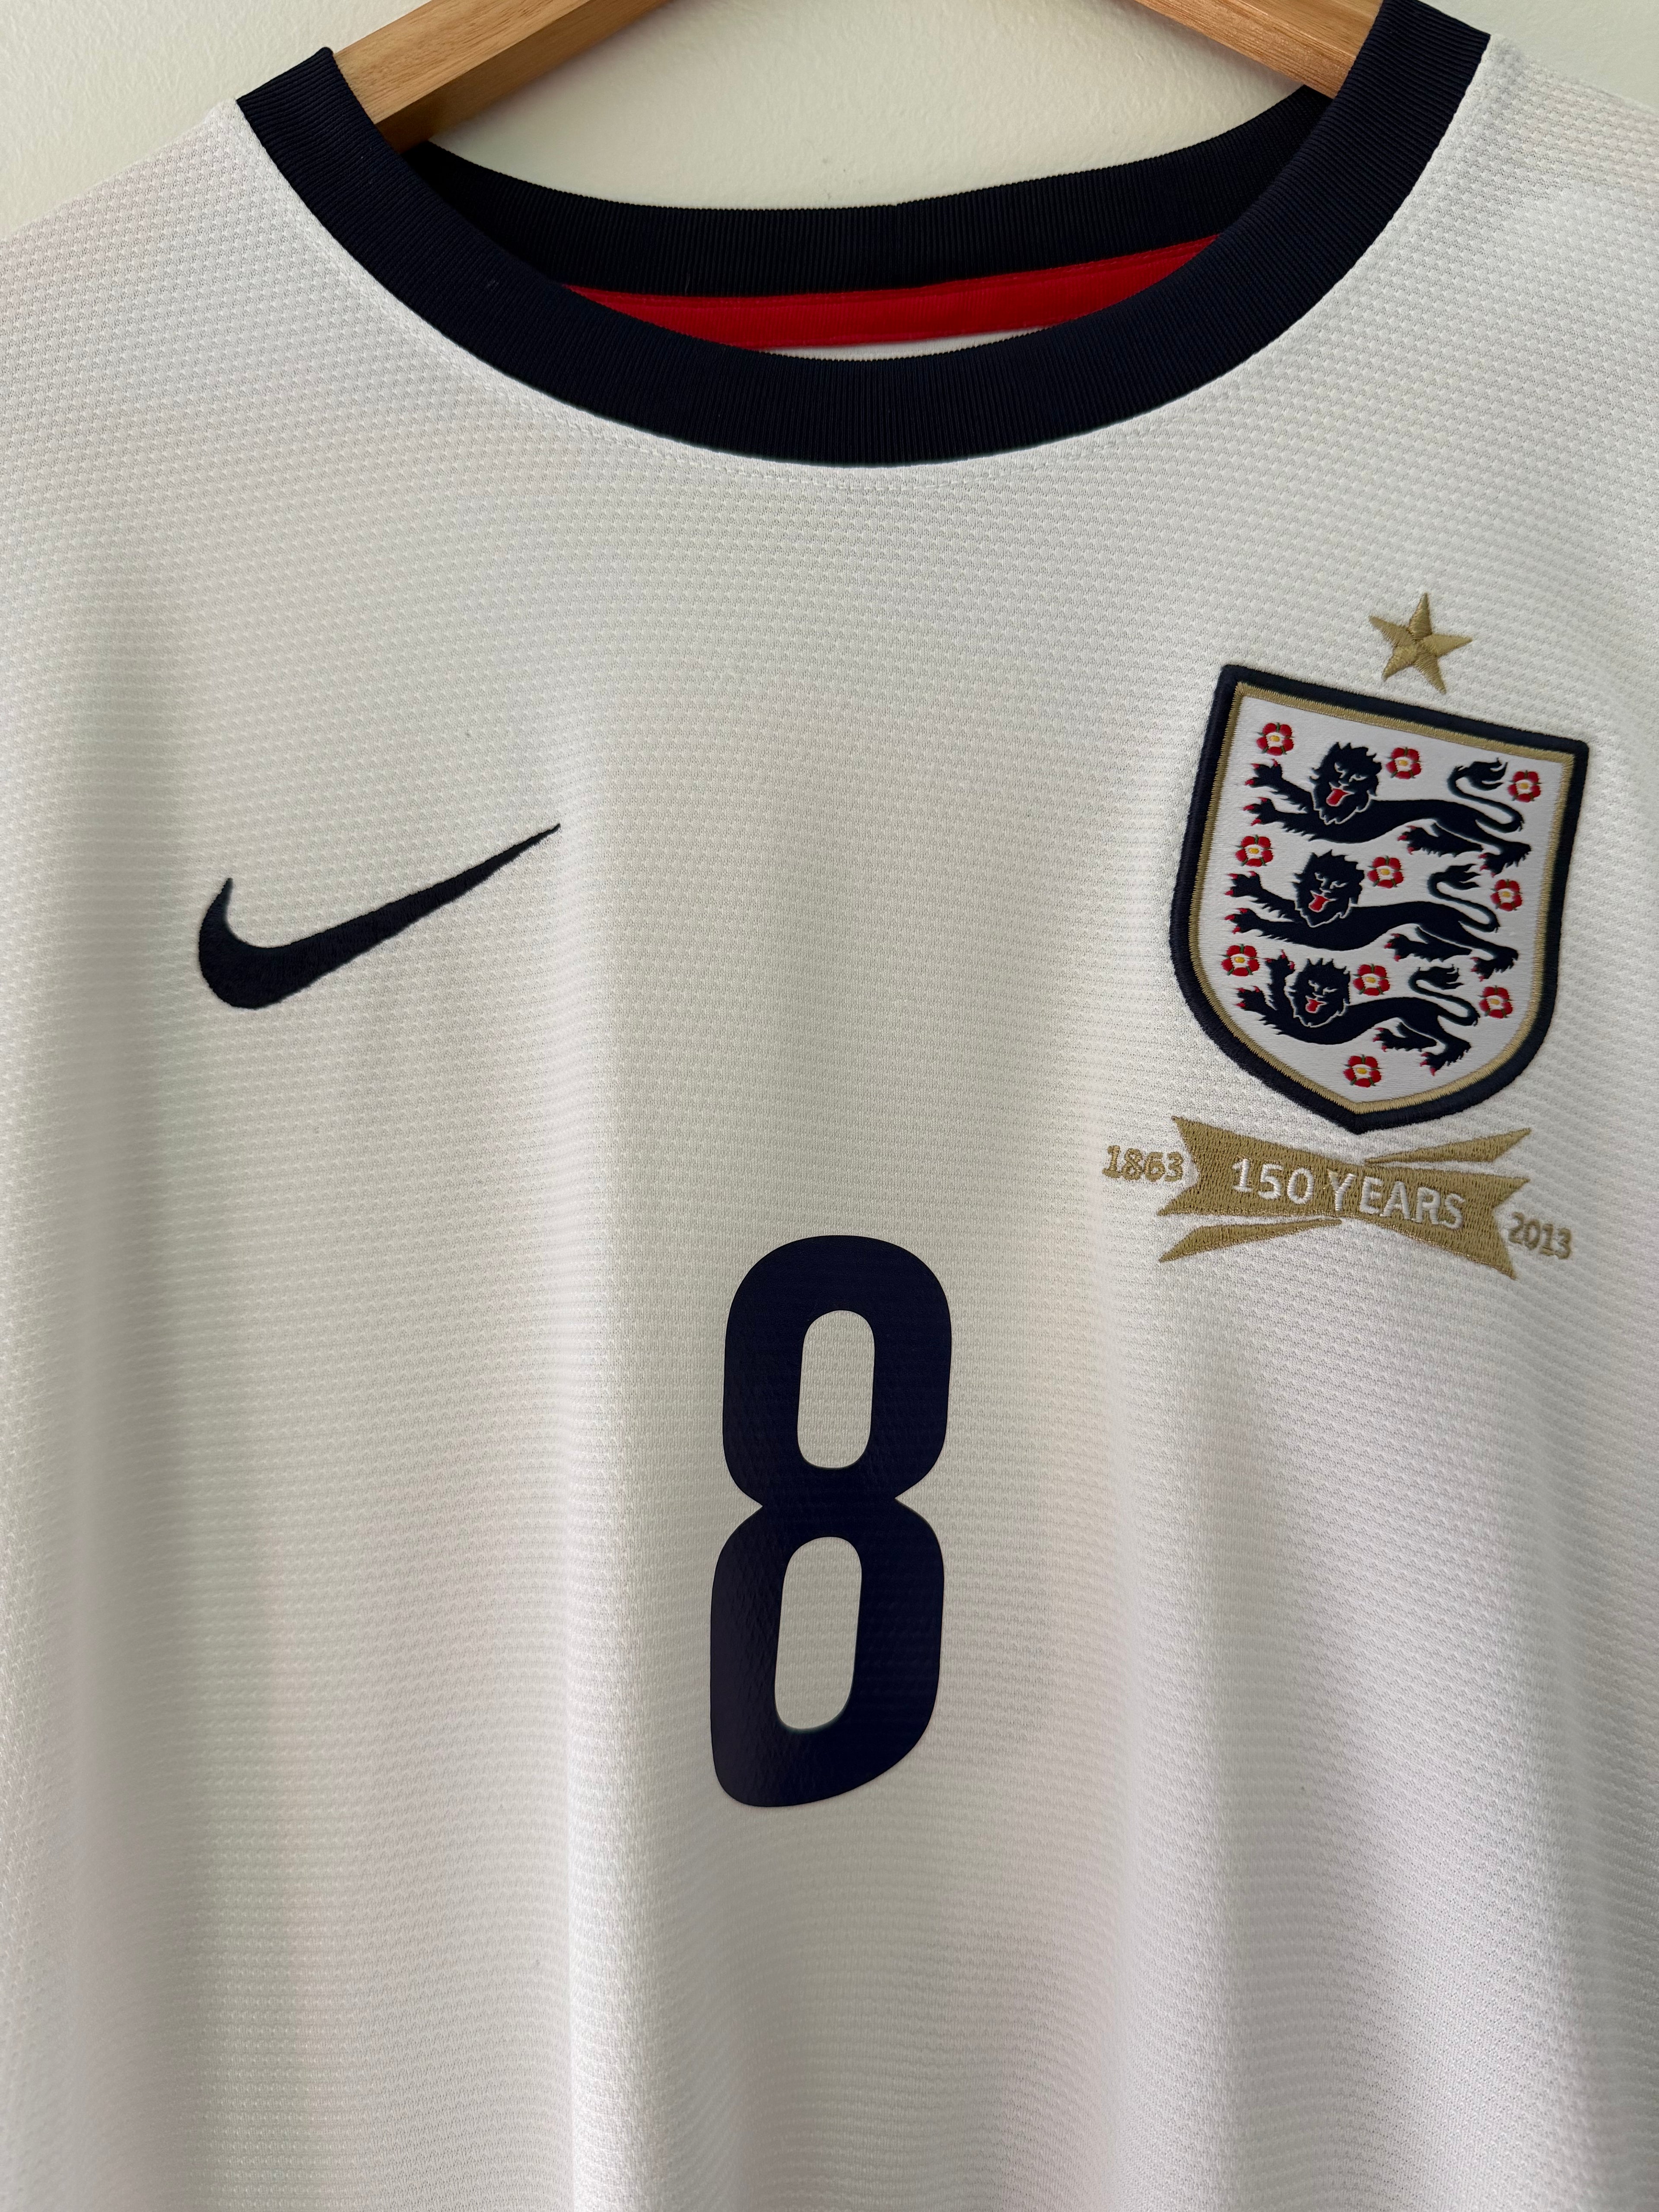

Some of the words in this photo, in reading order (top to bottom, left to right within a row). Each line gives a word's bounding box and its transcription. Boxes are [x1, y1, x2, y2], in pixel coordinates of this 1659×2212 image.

[1103, 1145, 1185, 1182] 1863
[1233, 1158, 1316, 1205] 150
[1327, 1171, 1464, 1230] YEARS
[1508, 1212, 1573, 1259] 2013
[710, 1235, 951, 1807] 8
